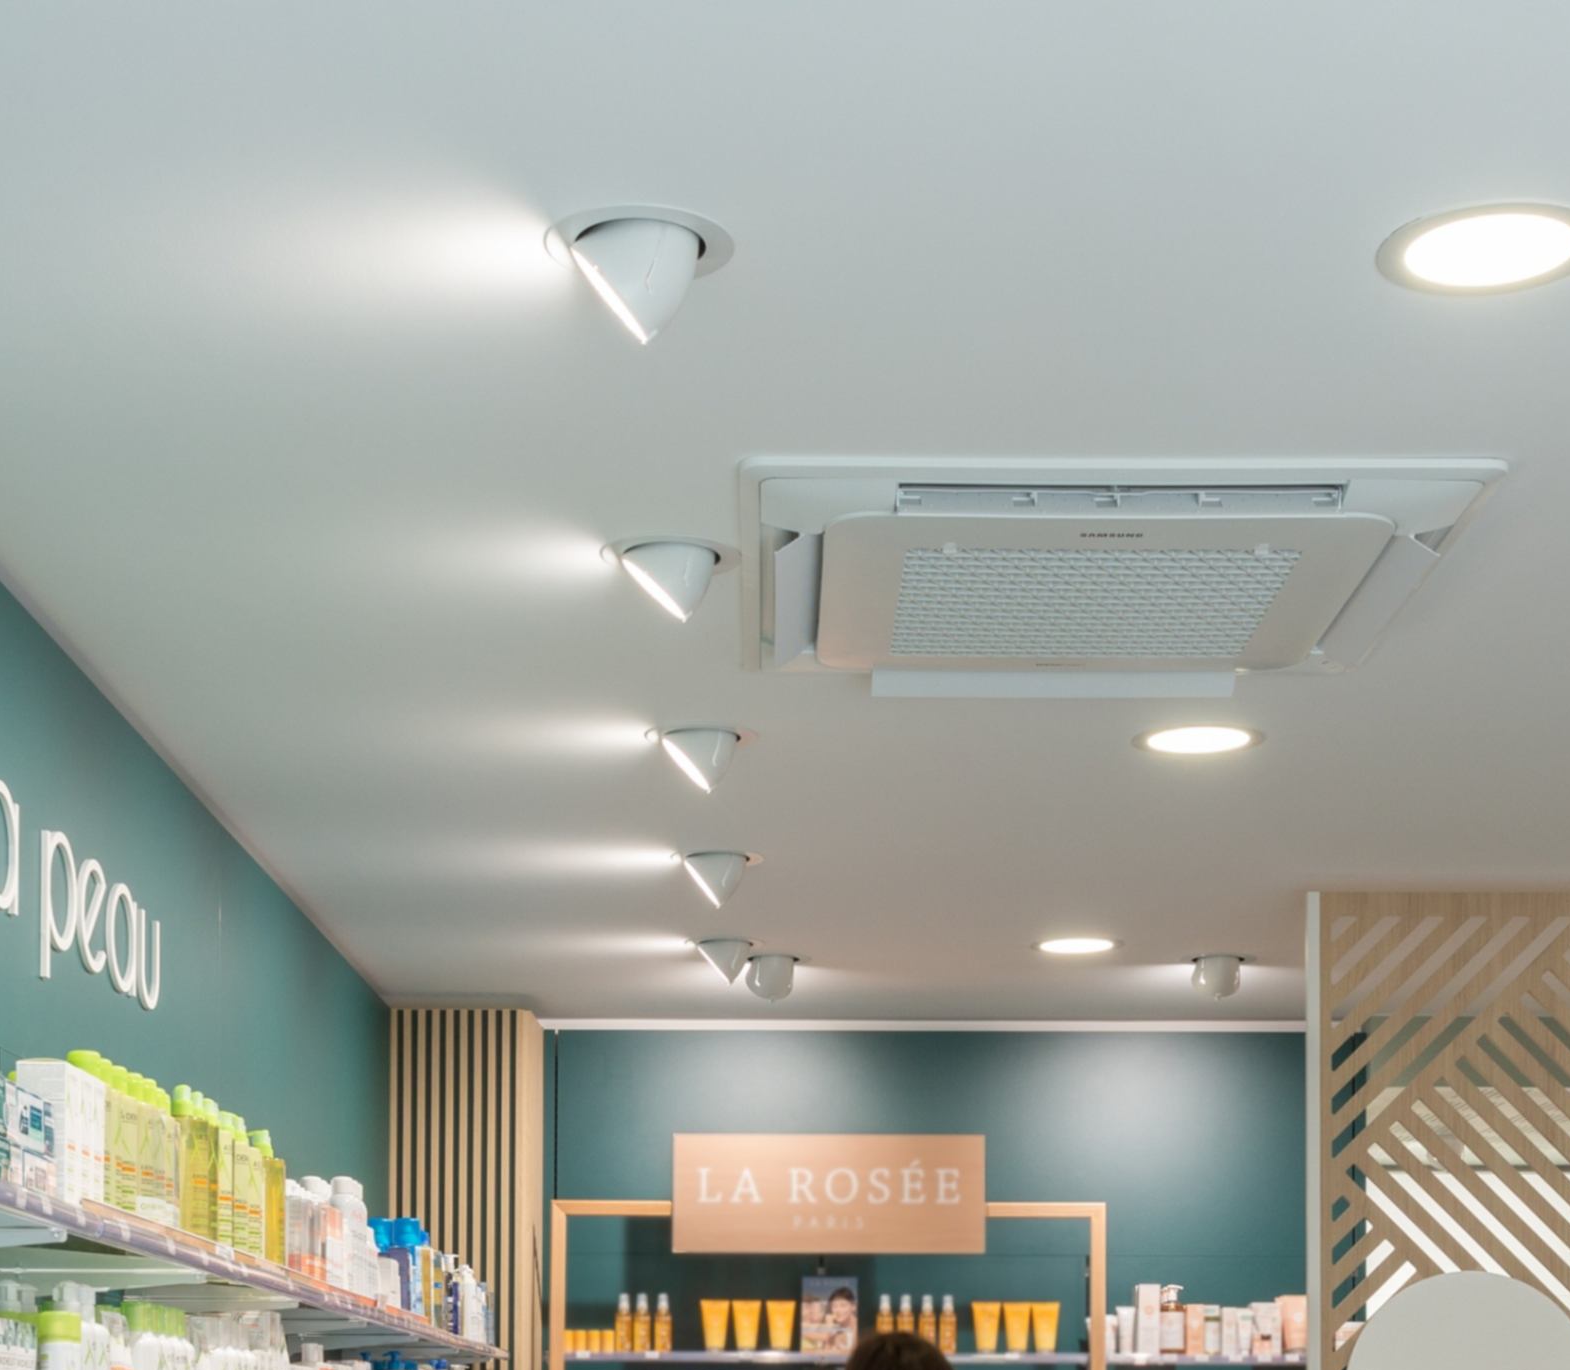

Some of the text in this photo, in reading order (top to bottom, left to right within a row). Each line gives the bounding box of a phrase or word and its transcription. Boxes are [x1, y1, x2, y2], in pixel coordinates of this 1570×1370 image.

[40, 829, 161, 1010] peau
[696, 1159, 962, 1206] LA ROSÉE
[792, 1214, 865, 1231] PARIS
